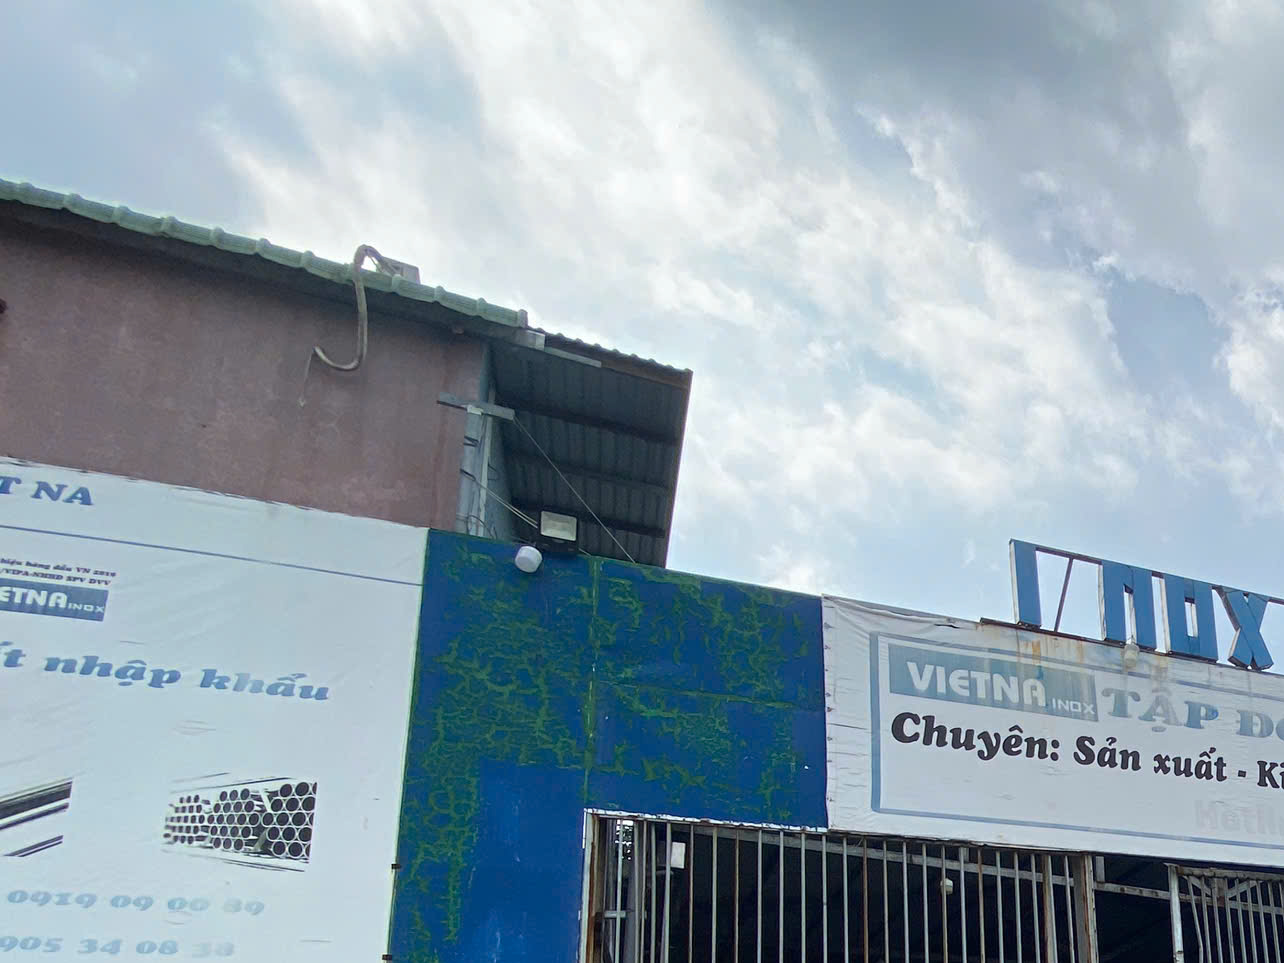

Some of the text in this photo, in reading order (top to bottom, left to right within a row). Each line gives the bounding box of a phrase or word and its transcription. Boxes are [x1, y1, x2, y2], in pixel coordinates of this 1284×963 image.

[30, 480, 95, 506] NA
[67, 602, 104, 613] INOX
[44, 656, 181, 688] nhập
[200, 668, 329, 701] khẩu
[907, 661, 1096, 715] VIETNA INOX
[1101, 686, 1220, 733] TẬP
[891, 711, 1061, 762] Chuyên:
[1073, 735, 1141, 772] Sản
[1153, 747, 1228, 782] xuất
[7, 890, 97, 909] 0919
[110, 895, 154, 911] 09
[77, 938, 122, 955] 34
